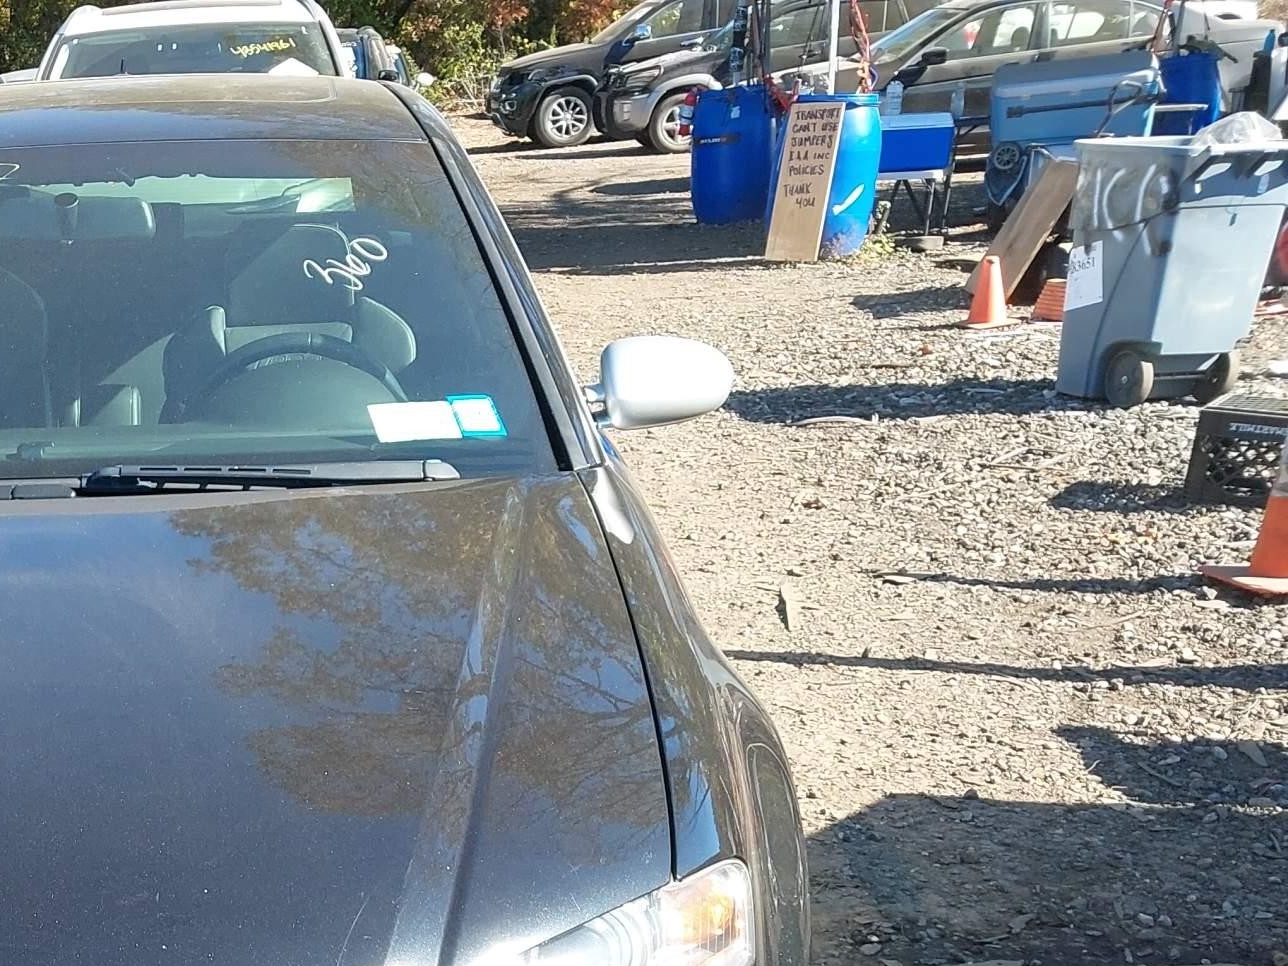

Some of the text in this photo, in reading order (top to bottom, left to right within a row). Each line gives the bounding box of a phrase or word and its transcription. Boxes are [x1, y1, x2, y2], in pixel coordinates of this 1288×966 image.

[795, 108, 841, 121] TRANSPORT
[821, 122, 839, 132] USE
[791, 135, 833, 149] JUMPERS
[813, 152, 830, 160] INC
[788, 164, 825, 176] POLICIES
[784, 183, 812, 197] THANK
[795, 197, 816, 208] YOU
[304, 237, 388, 290] 360
